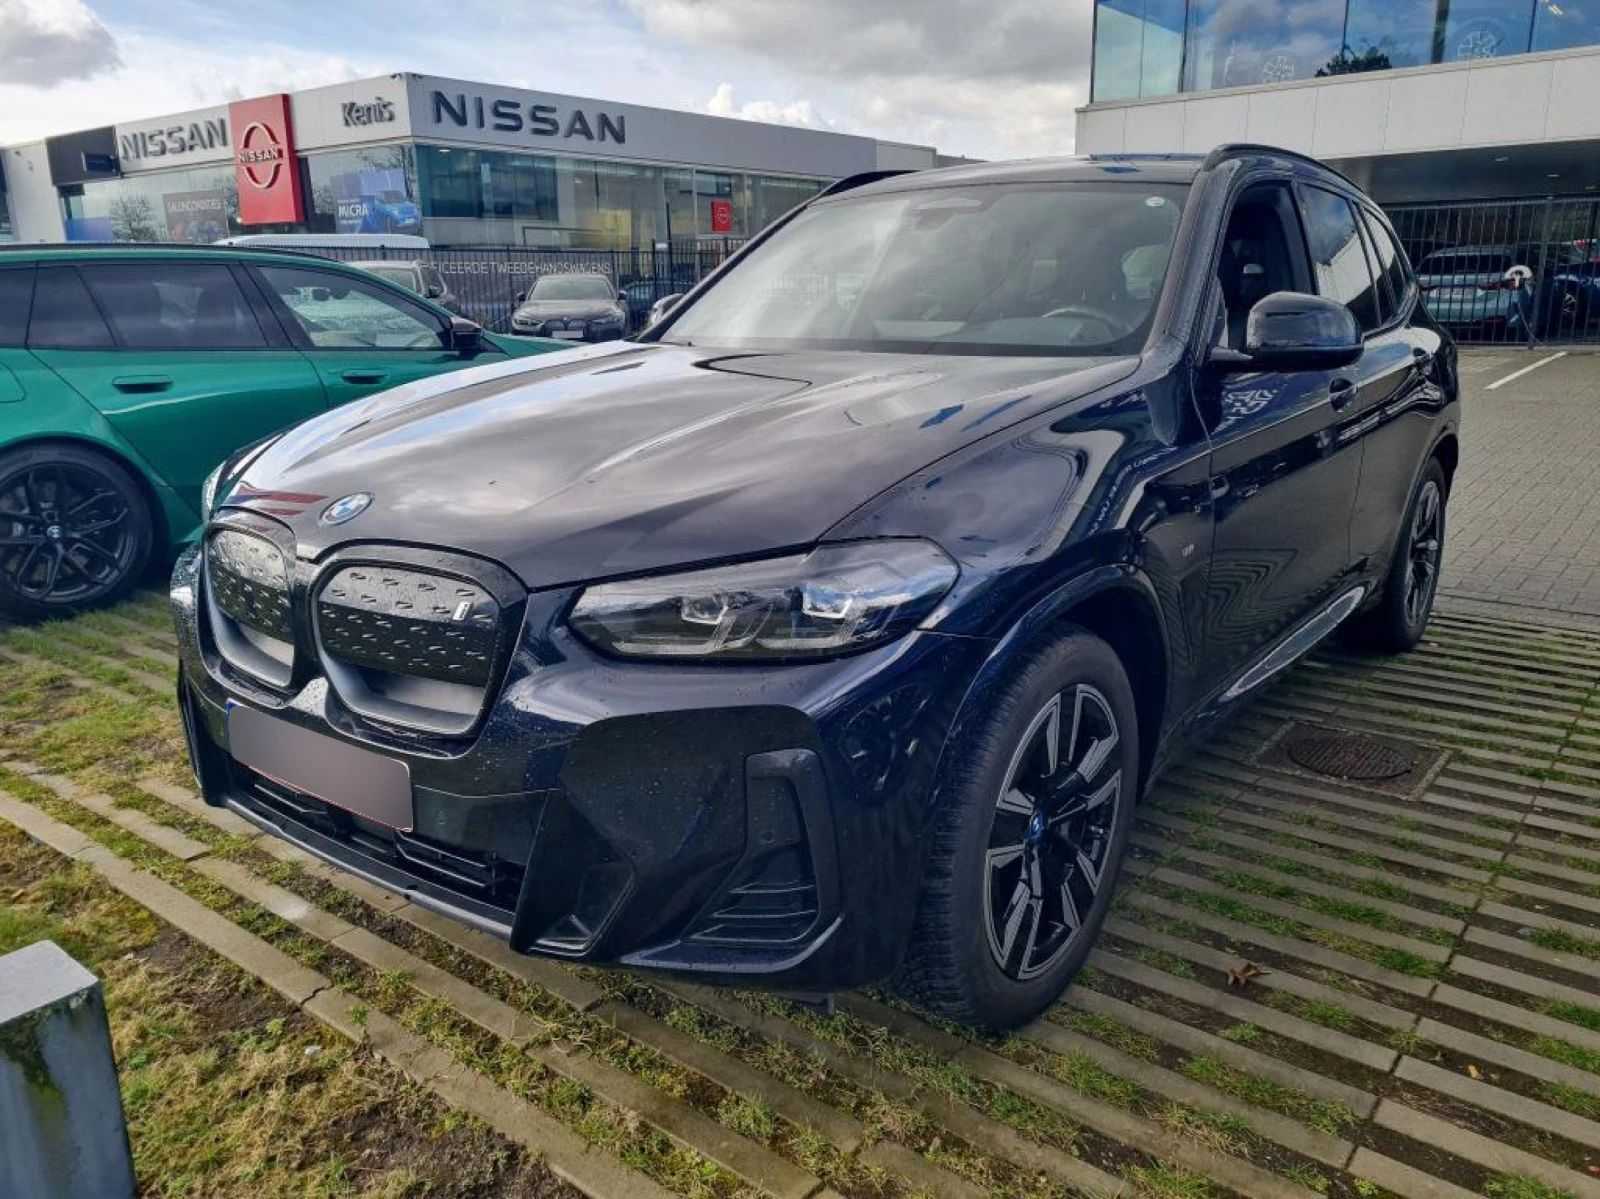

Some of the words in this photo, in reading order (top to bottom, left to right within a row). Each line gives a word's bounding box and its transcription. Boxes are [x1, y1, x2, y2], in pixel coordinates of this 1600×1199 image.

[341, 97, 394, 127] Kenis
[432, 90, 626, 144] NISSAN
[121, 118, 228, 161] NISSAN
[239, 148, 279, 164] NISSAN
[338, 204, 369, 218] MICRA
